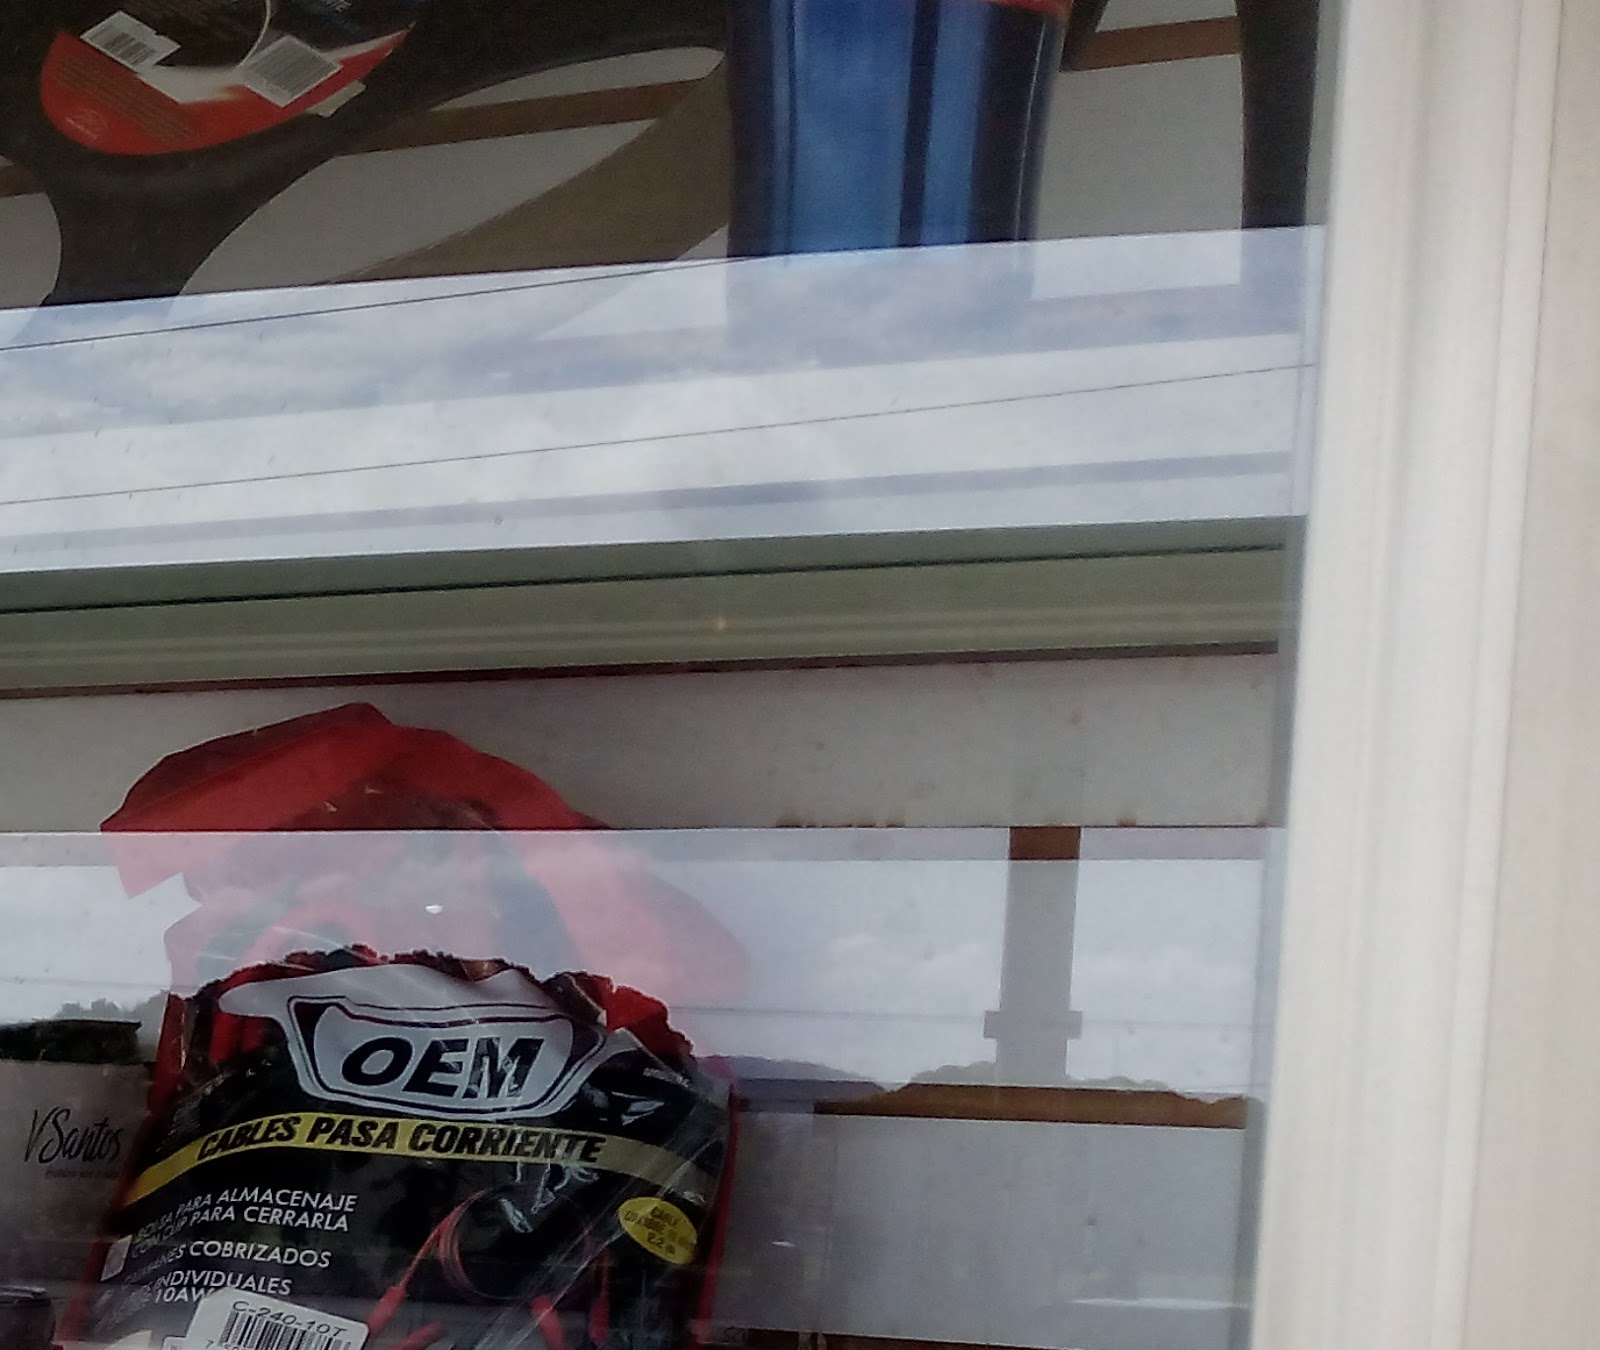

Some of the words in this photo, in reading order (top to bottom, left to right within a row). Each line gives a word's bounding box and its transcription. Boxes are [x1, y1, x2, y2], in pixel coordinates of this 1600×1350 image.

[341, 1036, 545, 1099] OEM
[197, 1115, 303, 1160] CABLES
[307, 1116, 399, 1149] PASA
[408, 1122, 607, 1164] CORRIENTE
[177, 1193, 212, 1217] PARA
[216, 1186, 358, 1212] ALMACENAJE
[190, 1206, 236, 1228] PARA
[243, 1206, 349, 1232] CERRARLA
[189, 1241, 332, 1268] COBRIZADOS
[154, 1270, 293, 1296] INDIVIDUALES
[233, 1300, 347, 1337] C-240-10T
